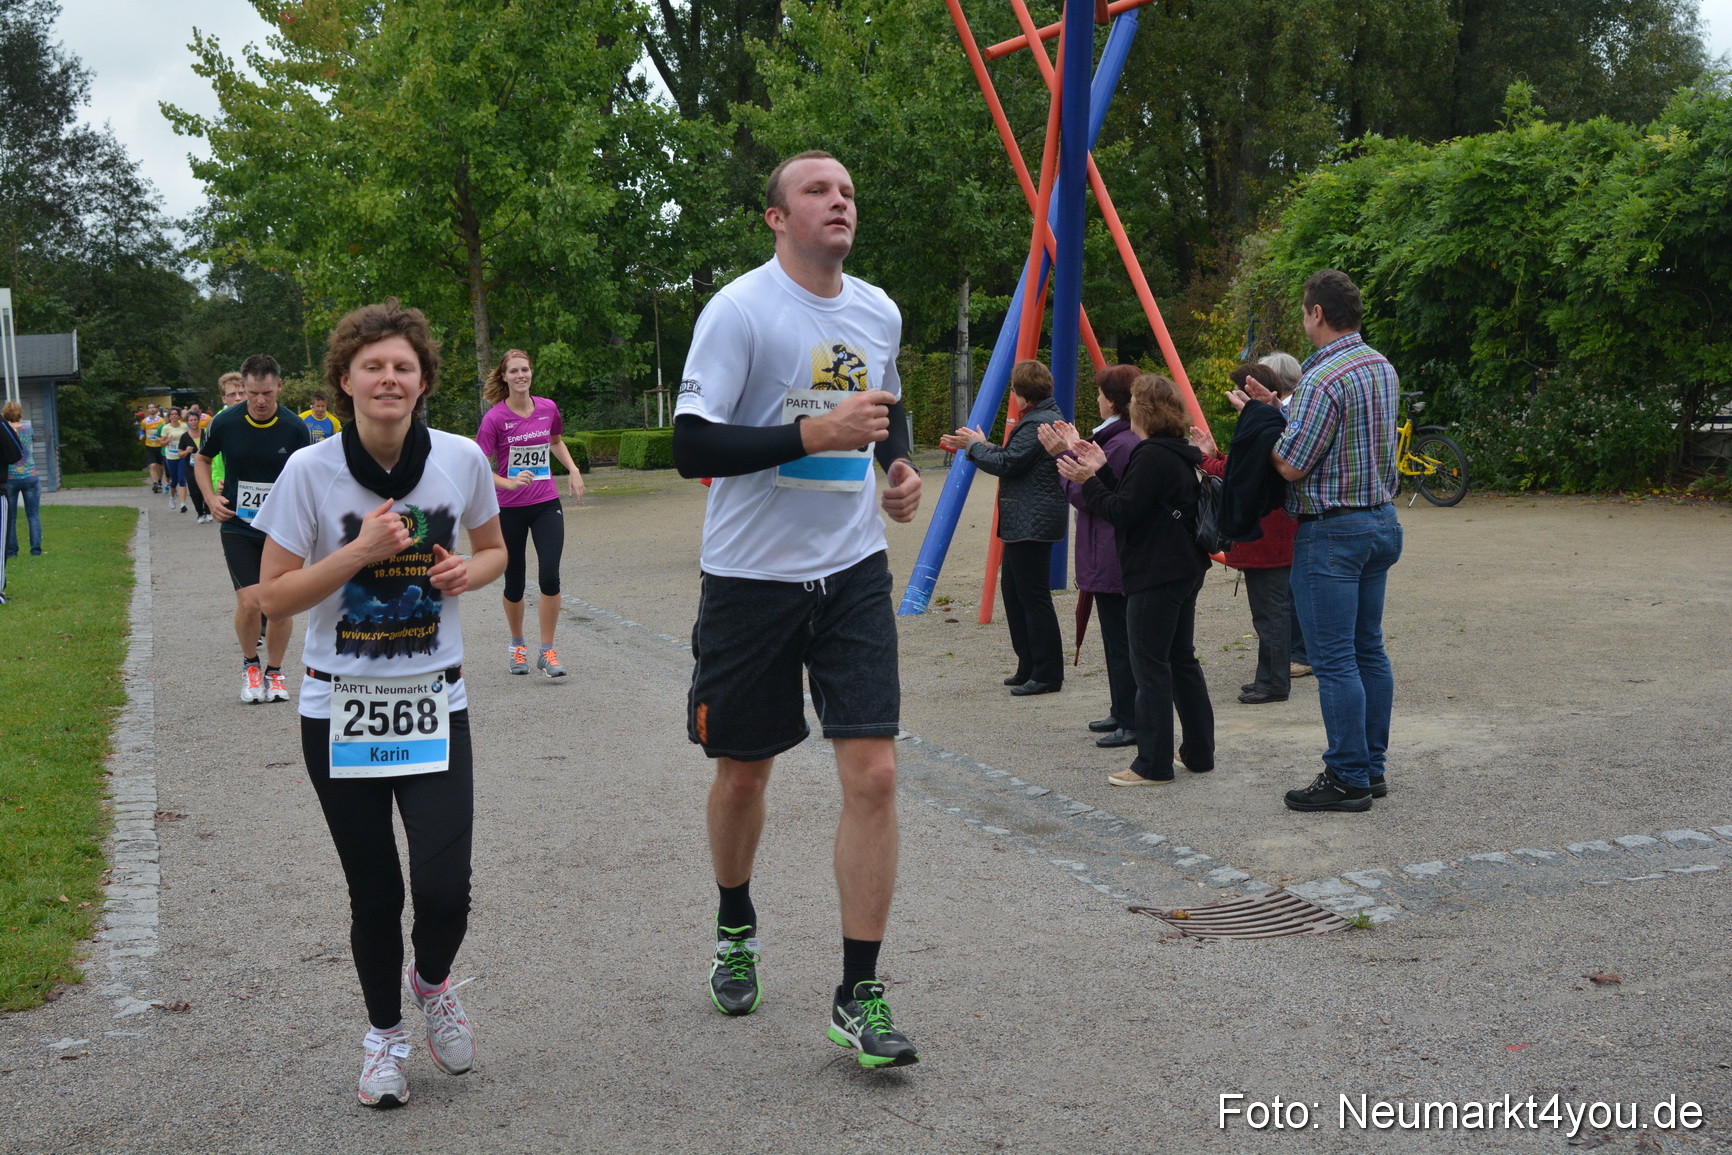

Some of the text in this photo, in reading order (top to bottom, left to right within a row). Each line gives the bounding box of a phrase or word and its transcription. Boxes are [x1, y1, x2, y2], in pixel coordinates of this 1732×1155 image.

[786, 398, 838, 409] PARTL Ne
[513, 450, 546, 466] 2494
[389, 551, 433, 564] Running
[374, 565, 428, 579] 18.05.2013
[334, 683, 428, 695] PARTL Neumarkt
[343, 697, 439, 737] 2568
[370, 746, 410, 762] Karin
